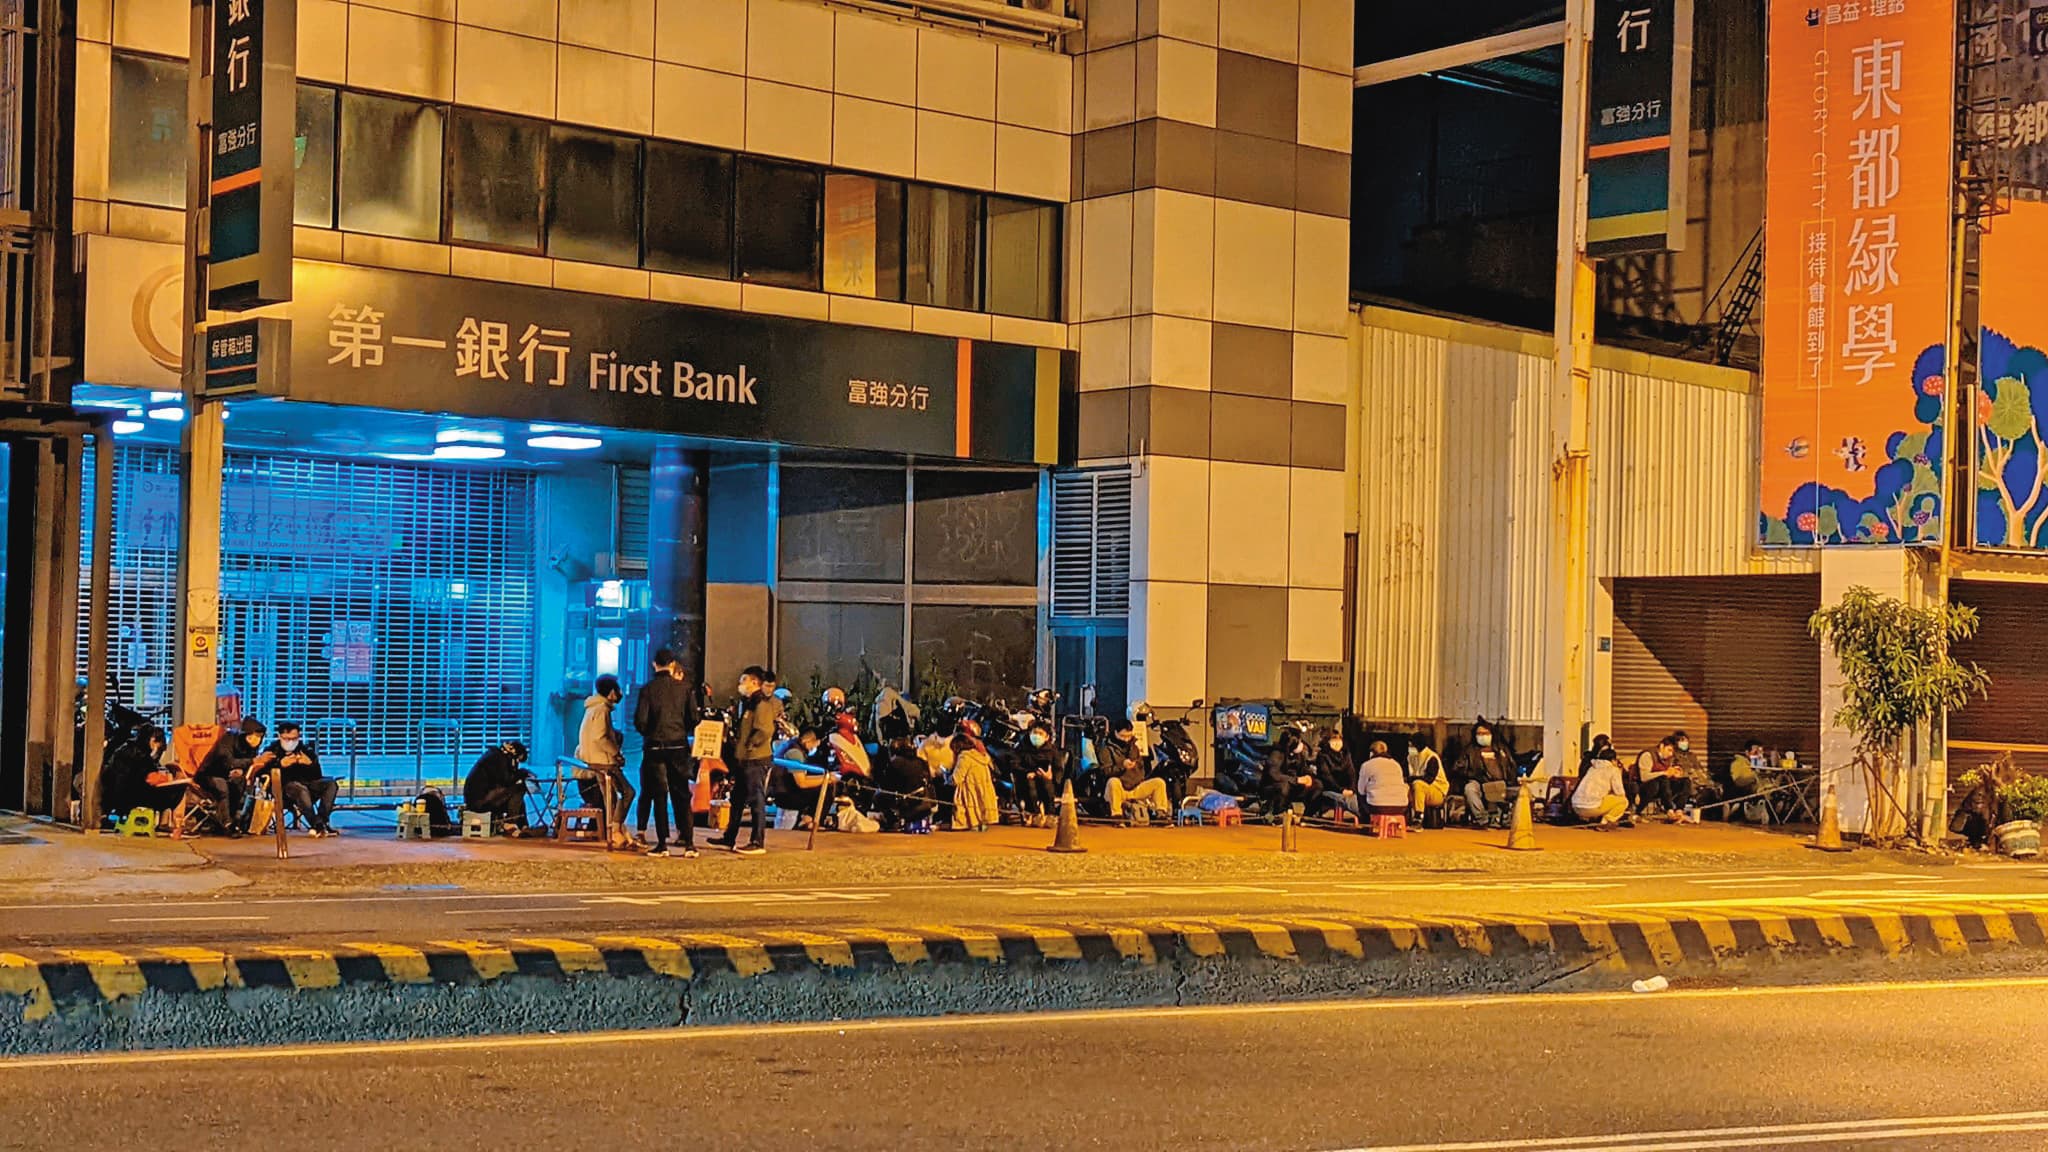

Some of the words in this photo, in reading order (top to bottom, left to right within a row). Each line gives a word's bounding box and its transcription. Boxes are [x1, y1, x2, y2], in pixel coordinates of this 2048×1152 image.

[1617, 8, 1651, 53] 行
[1601, 99, 1661, 126] 富強分行
[1811, 50, 1829, 135] GLORY
[217, 123, 257, 155] 富強分行
[1811, 152, 1827, 207] CITY
[1842, 38, 1904, 385] 東都綠學
[1807, 232, 1826, 378] 接待會館到了
[327, 302, 571, 387] 第一銀行
[589, 351, 663, 397] First
[673, 361, 757, 404] Bank
[848, 379, 930, 410] 富強分行
[1246, 720, 1266, 734] VAN
